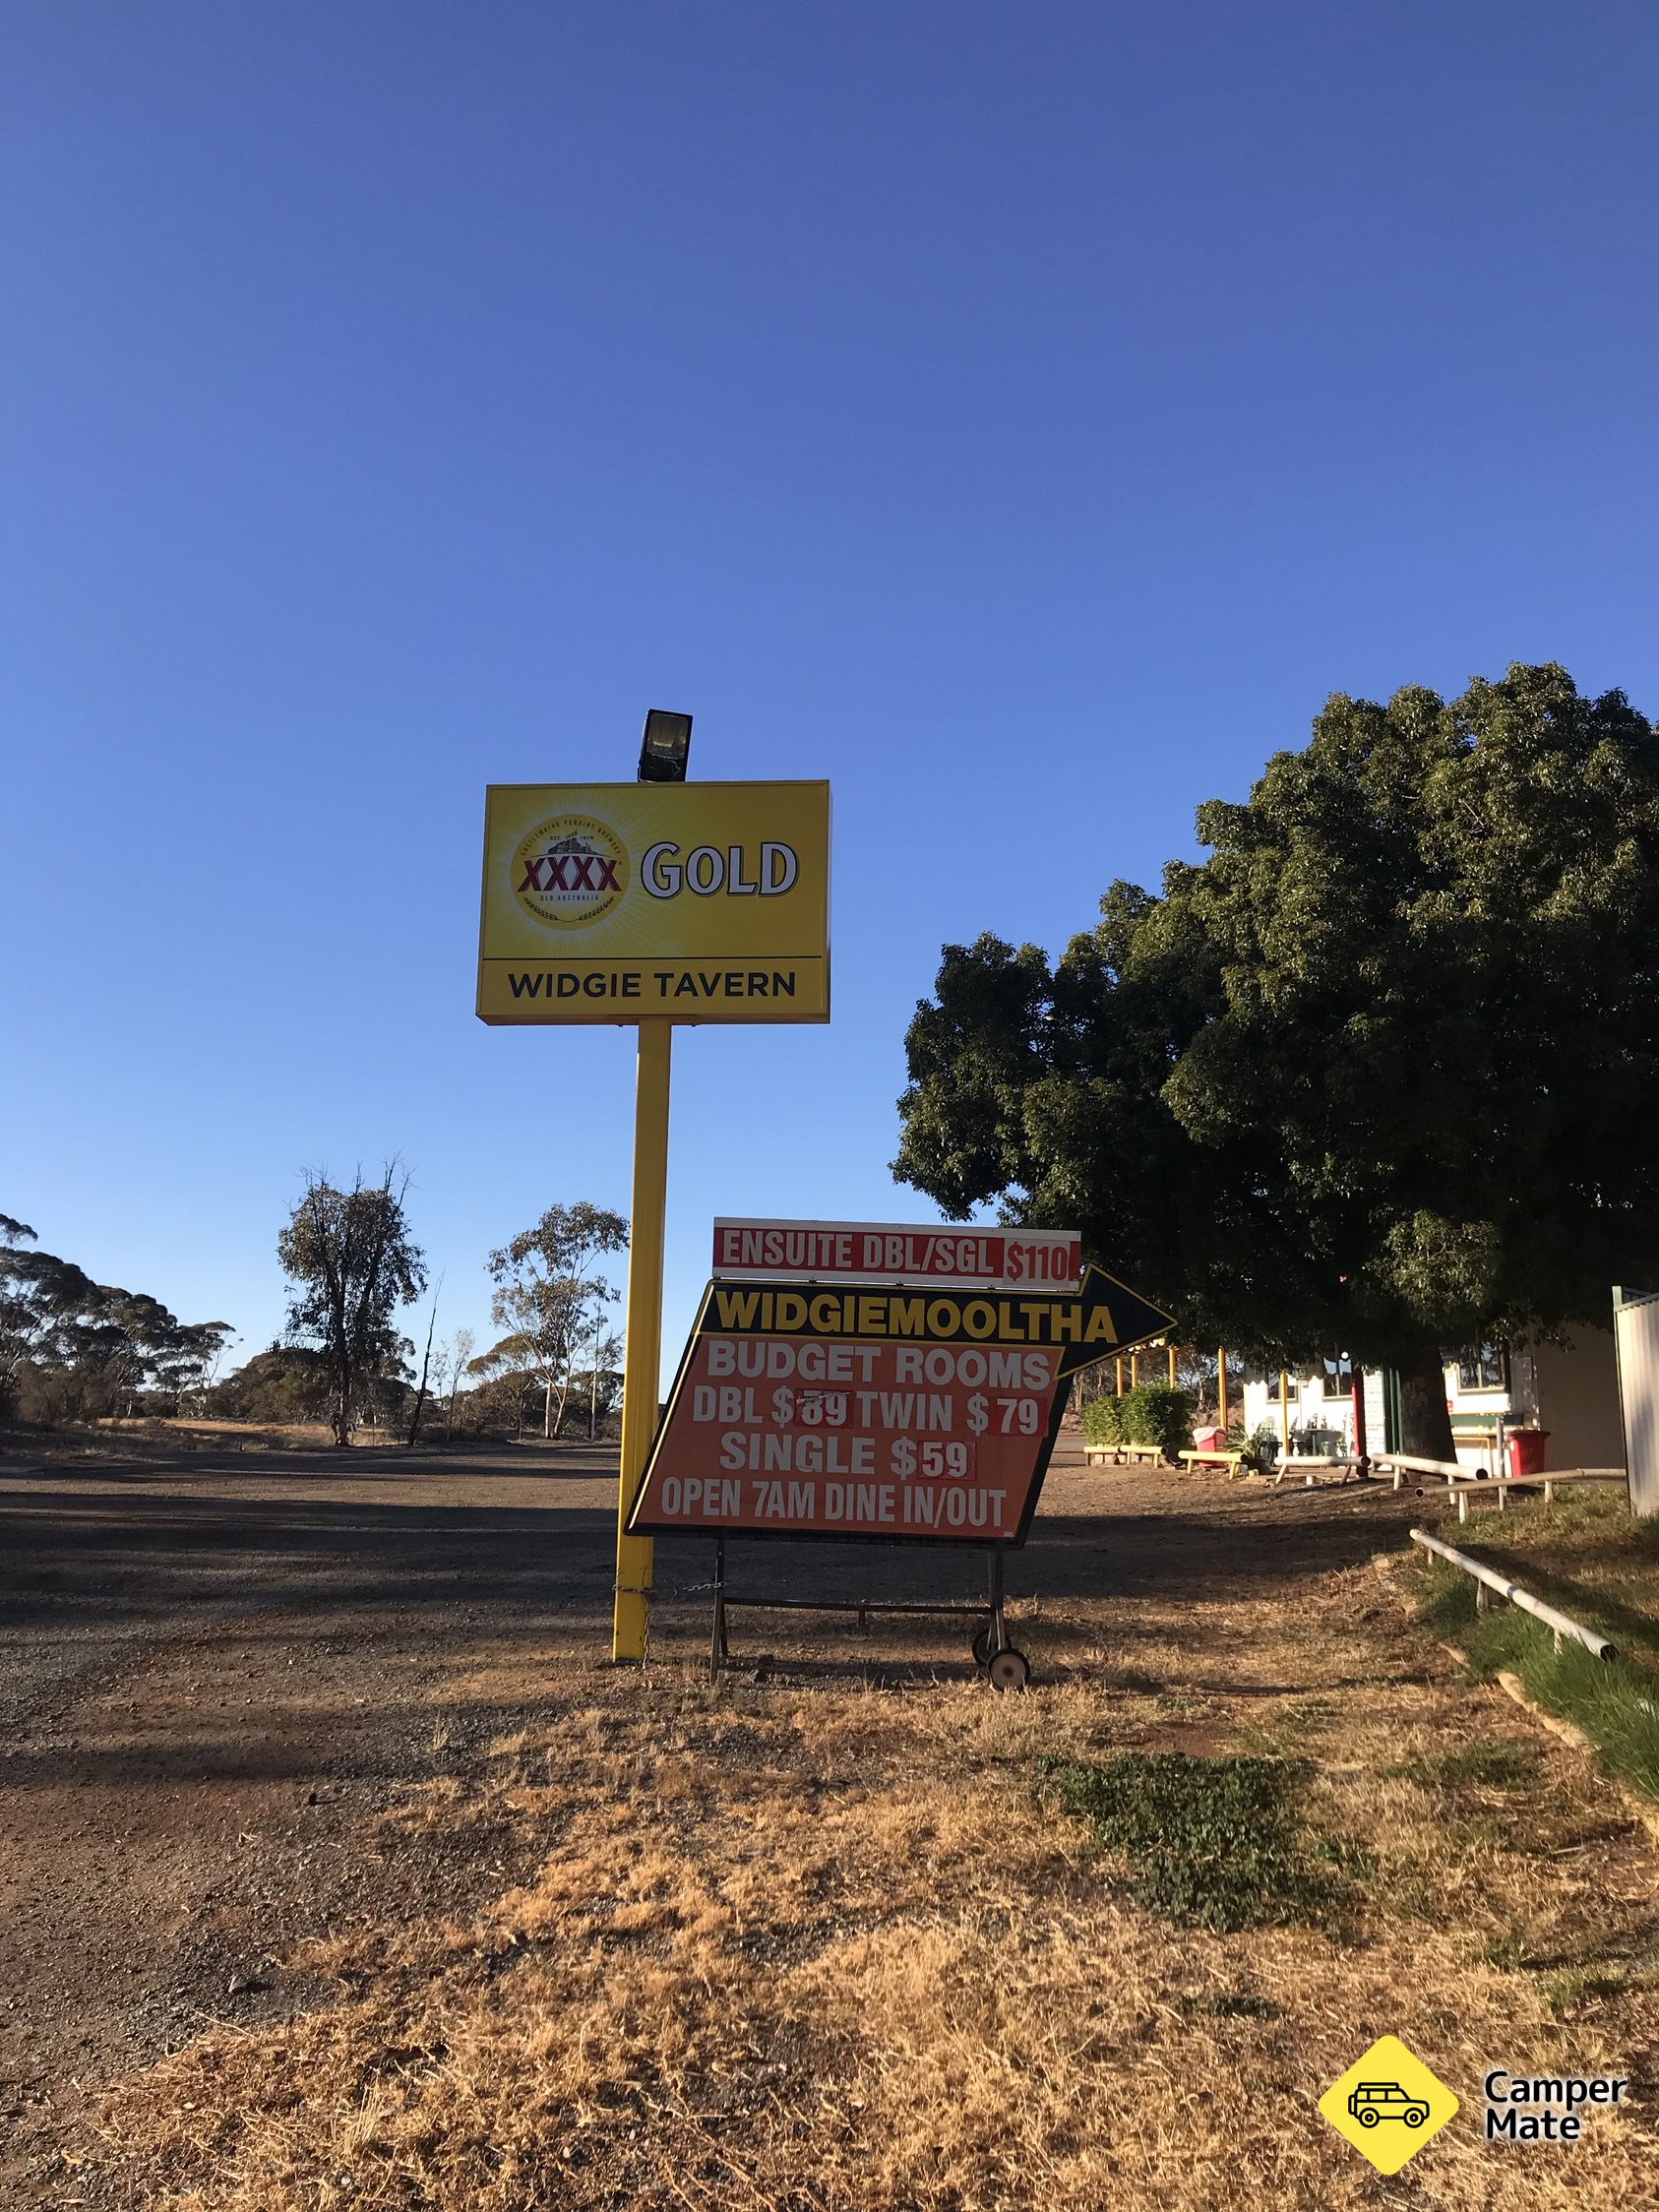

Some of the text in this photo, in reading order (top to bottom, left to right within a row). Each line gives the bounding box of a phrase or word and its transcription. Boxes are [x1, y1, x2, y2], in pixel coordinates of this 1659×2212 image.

[518, 856, 622, 892] XXXX
[641, 841, 800, 900] GOLD
[508, 972, 796, 999] WIDGIE TAVERN
[722, 1229, 1069, 1280] ENSUITE DBL/SGL $110
[715, 1290, 1119, 1344] WIDGIEMOOLTHA
[707, 1340, 1051, 1391] BUDGET ROOMS
[693, 1385, 764, 1424] DBL
[856, 1391, 952, 1432] TWIN
[719, 1431, 968, 1480] SINGLE $59
[661, 1476, 1008, 1528] OPEN 7AM DINE IN/OUT
